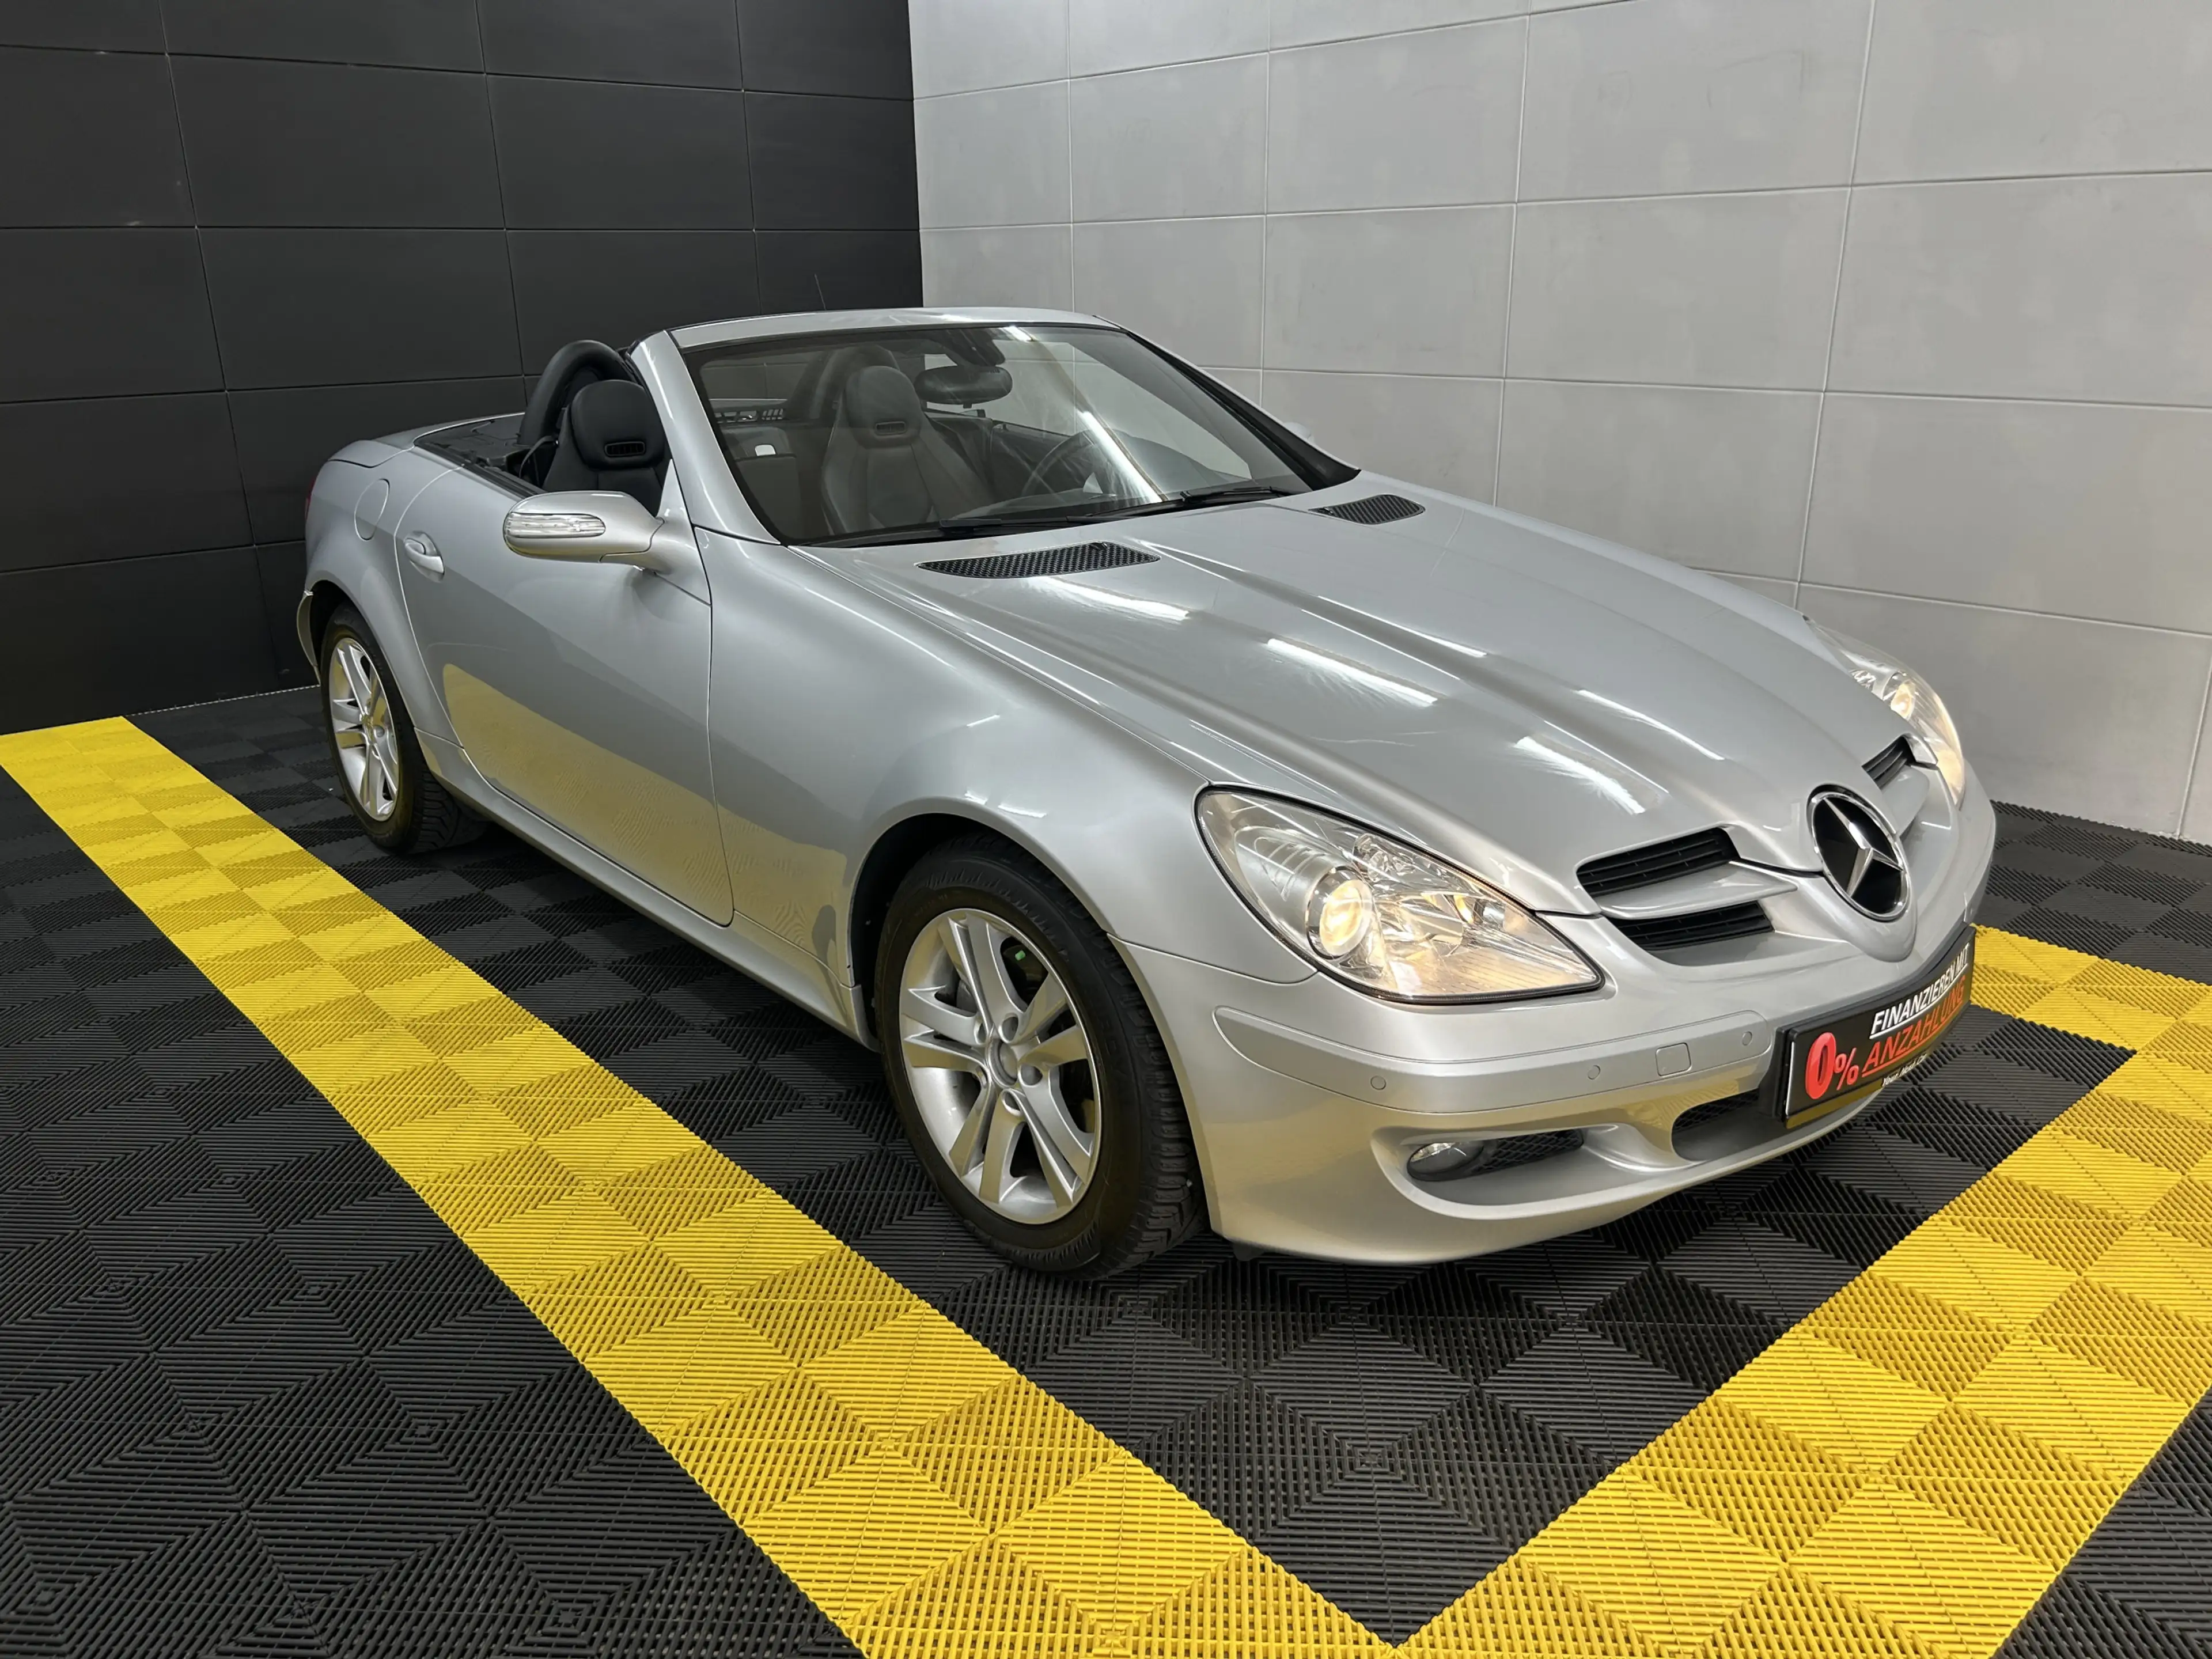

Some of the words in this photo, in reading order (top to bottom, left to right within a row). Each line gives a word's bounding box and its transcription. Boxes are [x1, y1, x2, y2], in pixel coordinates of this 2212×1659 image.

[1805, 1032, 1859, 1100] 0%
[1861, 975, 1965, 1073] ANZAHLUNG
[1870, 960, 1956, 1035] FINANZIEREN
[1955, 942, 1969, 976] MIT
